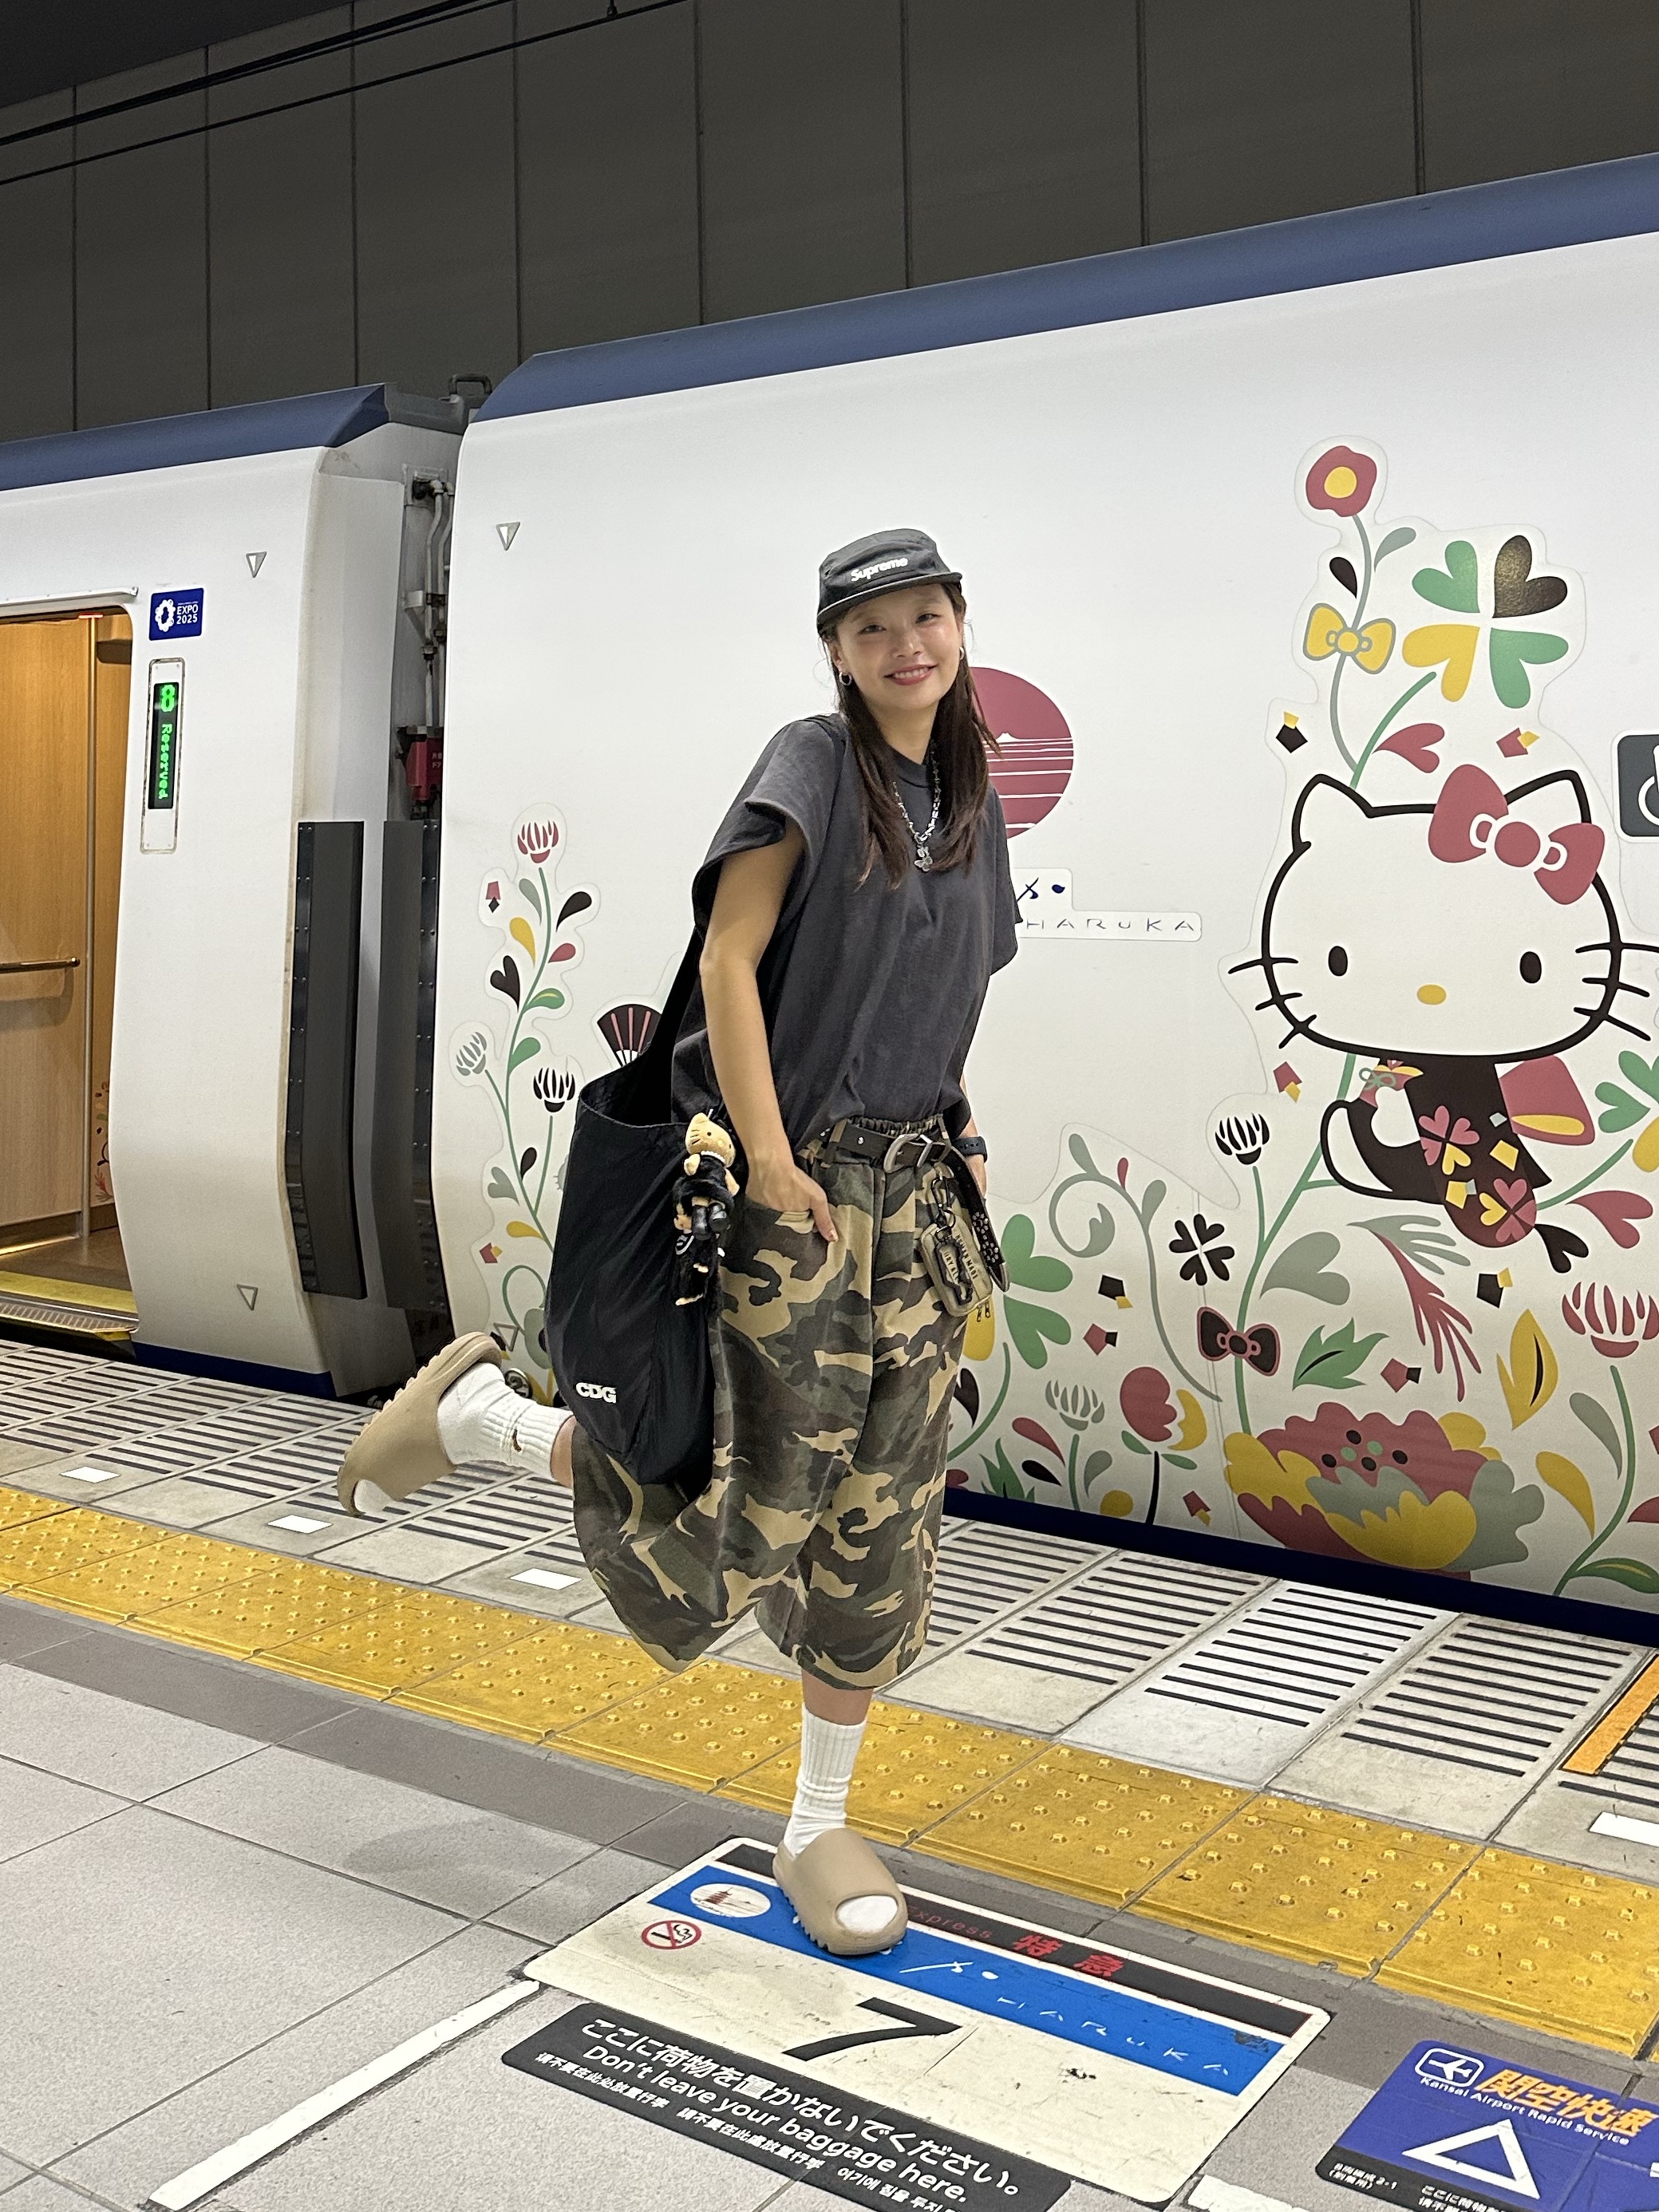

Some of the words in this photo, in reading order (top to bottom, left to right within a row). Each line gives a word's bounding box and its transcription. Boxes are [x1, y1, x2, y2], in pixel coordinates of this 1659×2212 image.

[851, 558, 908, 582] Supreme
[176, 604, 199, 615] EXPO
[575, 584, 617, 606] CDG
[176, 614, 198, 625] 2025
[161, 684, 176, 712] 8
[158, 723, 173, 800] Reserved
[1026, 918, 1194, 931] HARUKA
[1013, 1934, 1124, 1977] 特急
[780, 1997, 962, 2061] 7
[997, 1997, 1229, 2076] HARUKA
[582, 2019, 1018, 2195] ここに荷物を置かないでください。
[583, 2045, 653, 2080] Don't
[650, 2070, 717, 2103] leave
[712, 2098, 780, 2126] your
[778, 2118, 896, 2172] baggage
[899, 2163, 966, 2202] here.
[1420, 2076, 1470, 2097] Kansai
[1470, 2092, 1525, 2115] Airport
[1527, 2108, 1573, 2130] Rapid
[1574, 2123, 1629, 2146] Service
[1474, 2069, 1659, 2137] 関空快速
[837, 2167, 882, 2190] 여기에
